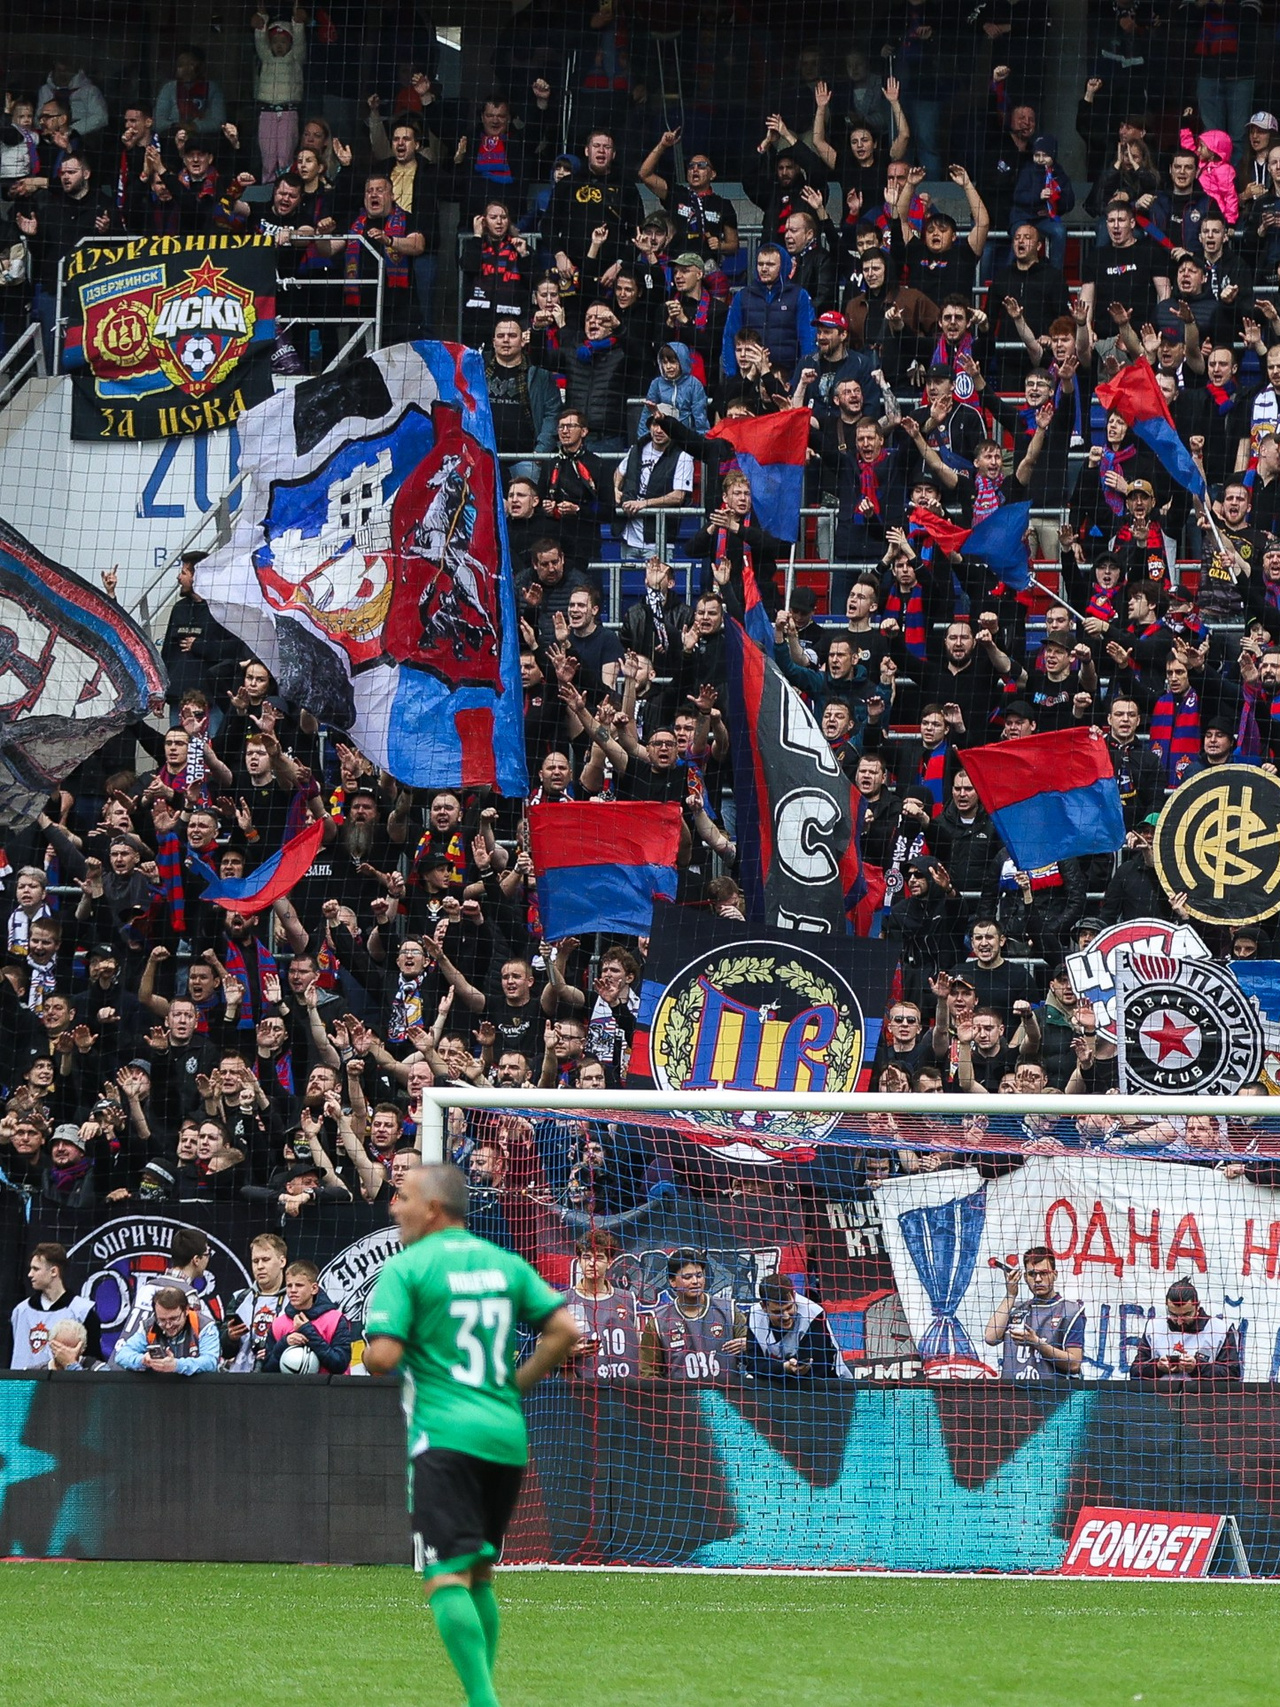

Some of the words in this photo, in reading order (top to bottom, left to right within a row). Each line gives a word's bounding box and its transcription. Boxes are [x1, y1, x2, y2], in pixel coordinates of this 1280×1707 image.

[86, 271, 159, 301] ДЗЕРЖИНСК
[153, 296, 247, 339] ЦСКА
[100, 407, 135, 438] ЗА
[158, 389, 247, 437] ЦСКА
[305, 864, 333, 877] ЗАНЬ
[1126, 995, 1217, 1043] FUDBALSKI
[1153, 1066, 1203, 1084] KLUB
[1045, 1198, 1207, 1278] ОДНА
[450, 1297, 512, 1388] 37
[685, 1349, 720, 1379] 036
[1066, 1519, 1213, 1572] FONBET
